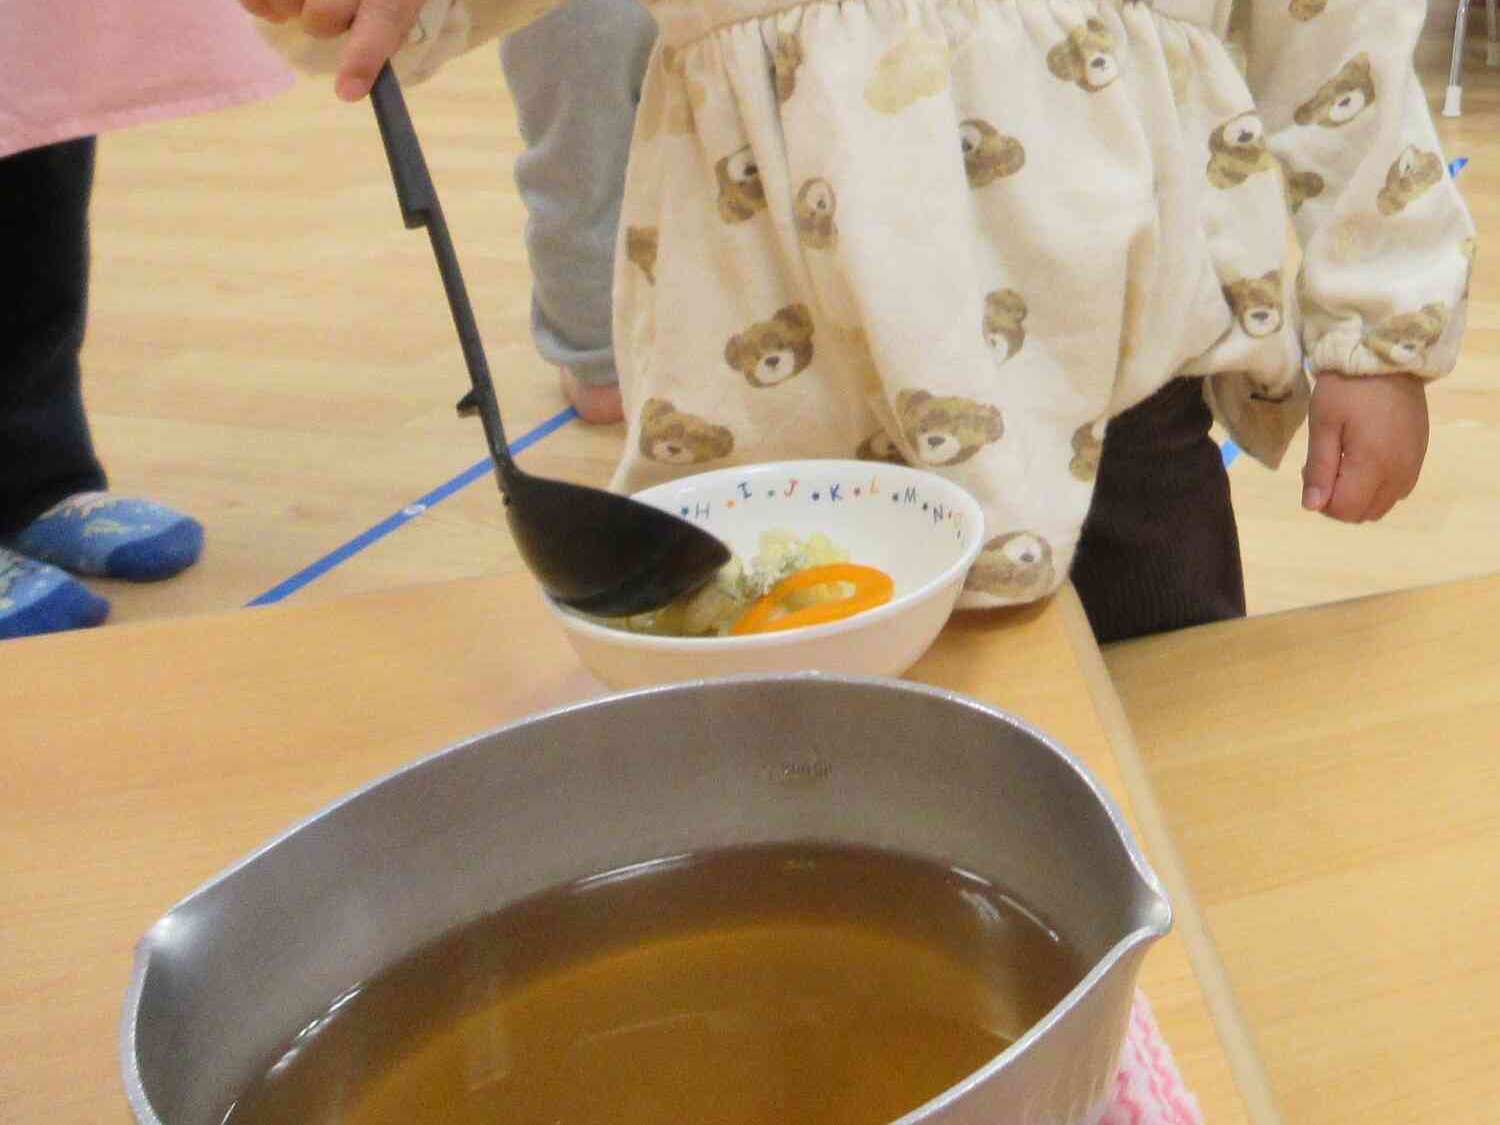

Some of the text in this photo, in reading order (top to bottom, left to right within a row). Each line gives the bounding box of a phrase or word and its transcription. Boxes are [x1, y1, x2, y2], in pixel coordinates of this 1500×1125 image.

[695, 475, 944, 523] H I J K L M N
